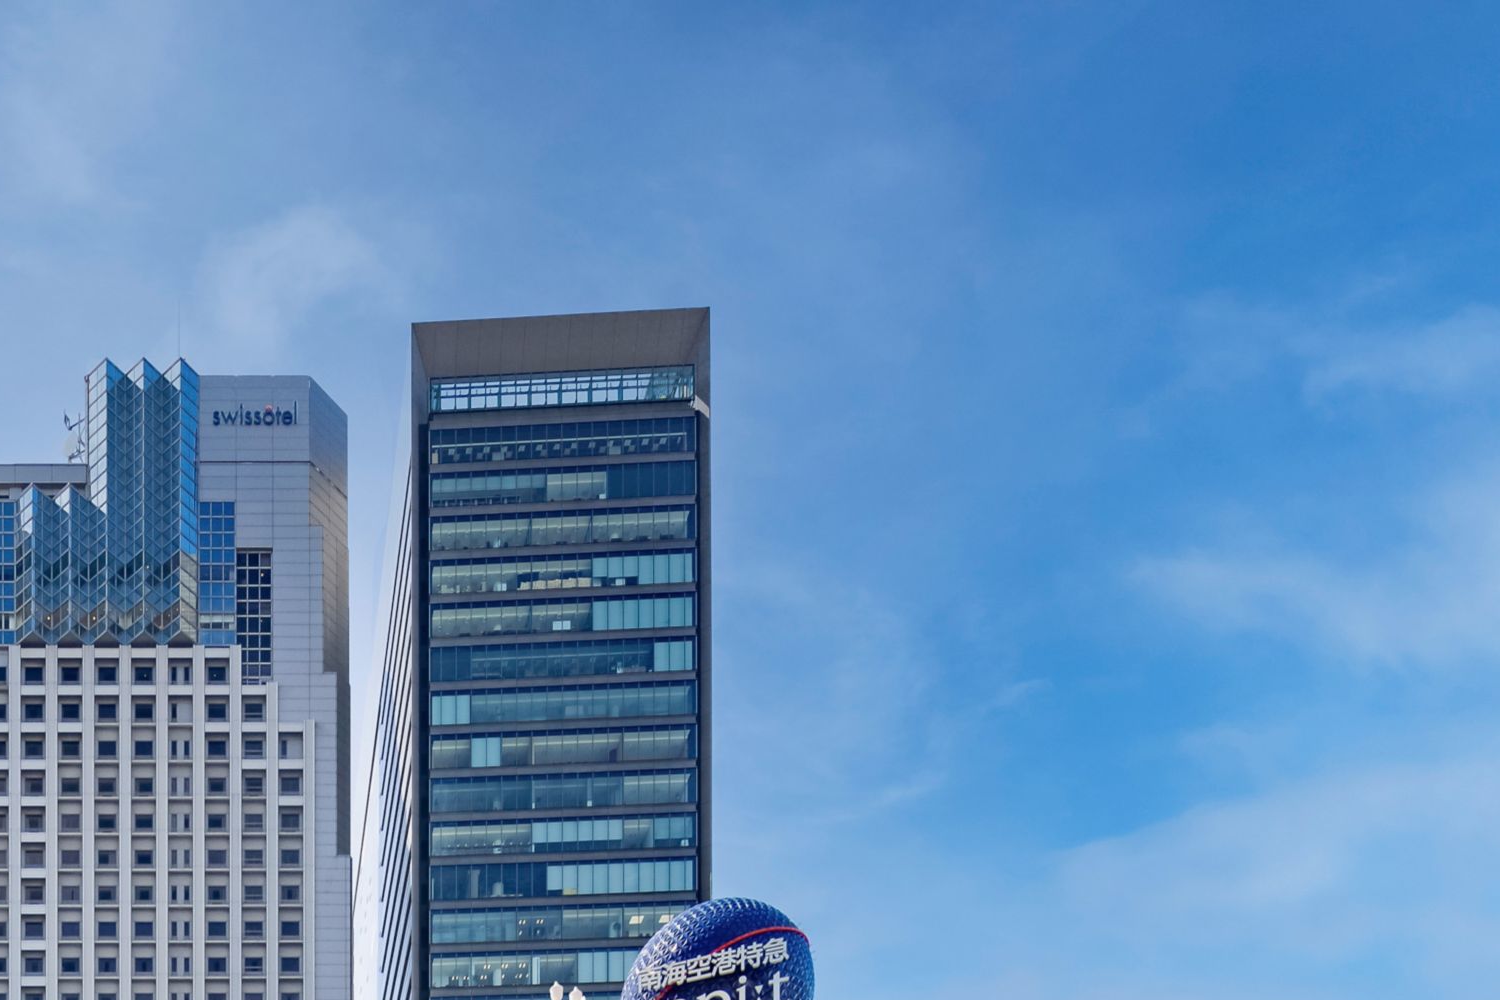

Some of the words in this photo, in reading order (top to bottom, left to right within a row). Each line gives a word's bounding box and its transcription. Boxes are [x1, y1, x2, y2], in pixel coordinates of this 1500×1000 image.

[638, 937, 790, 991] 南海空港特急
